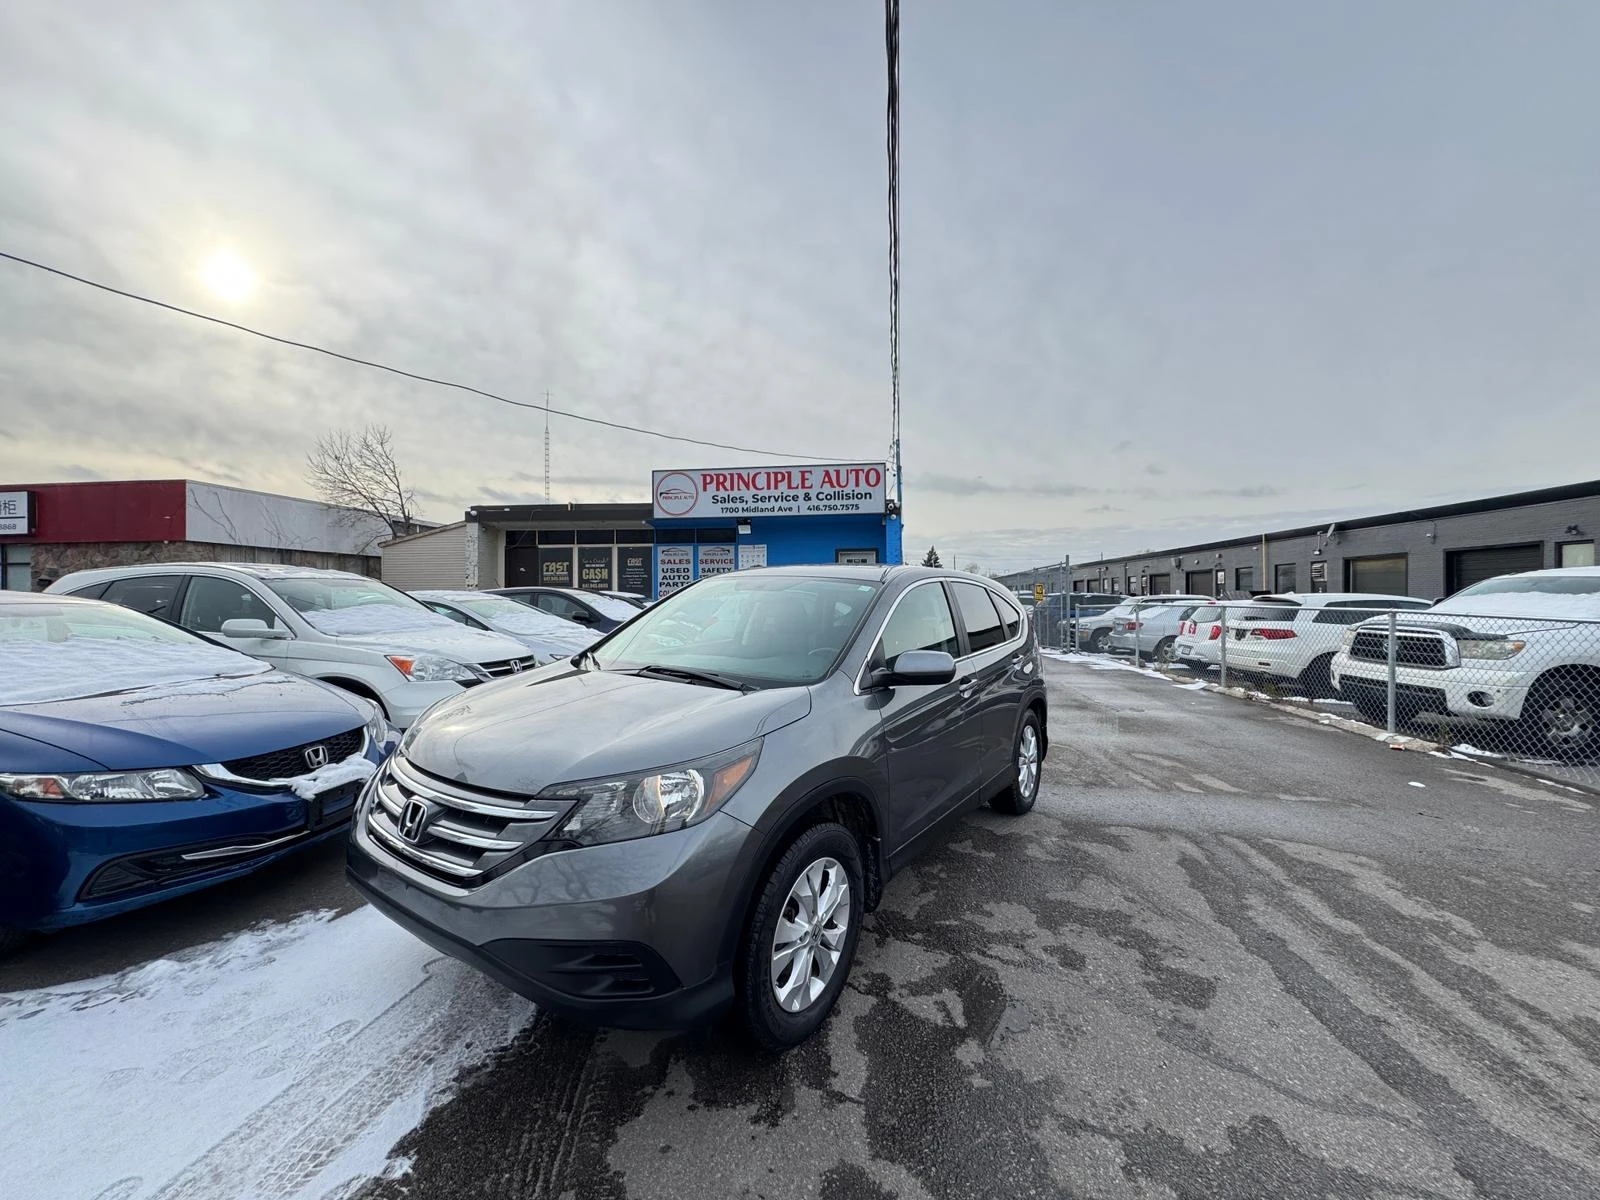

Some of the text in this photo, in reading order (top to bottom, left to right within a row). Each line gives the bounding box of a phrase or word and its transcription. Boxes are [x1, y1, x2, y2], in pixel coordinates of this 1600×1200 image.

[701, 467, 881, 492] PRINCIPLE AUTO
[712, 490, 872, 505] Sales, Service & Collision
[543, 561, 570, 573] FAST
